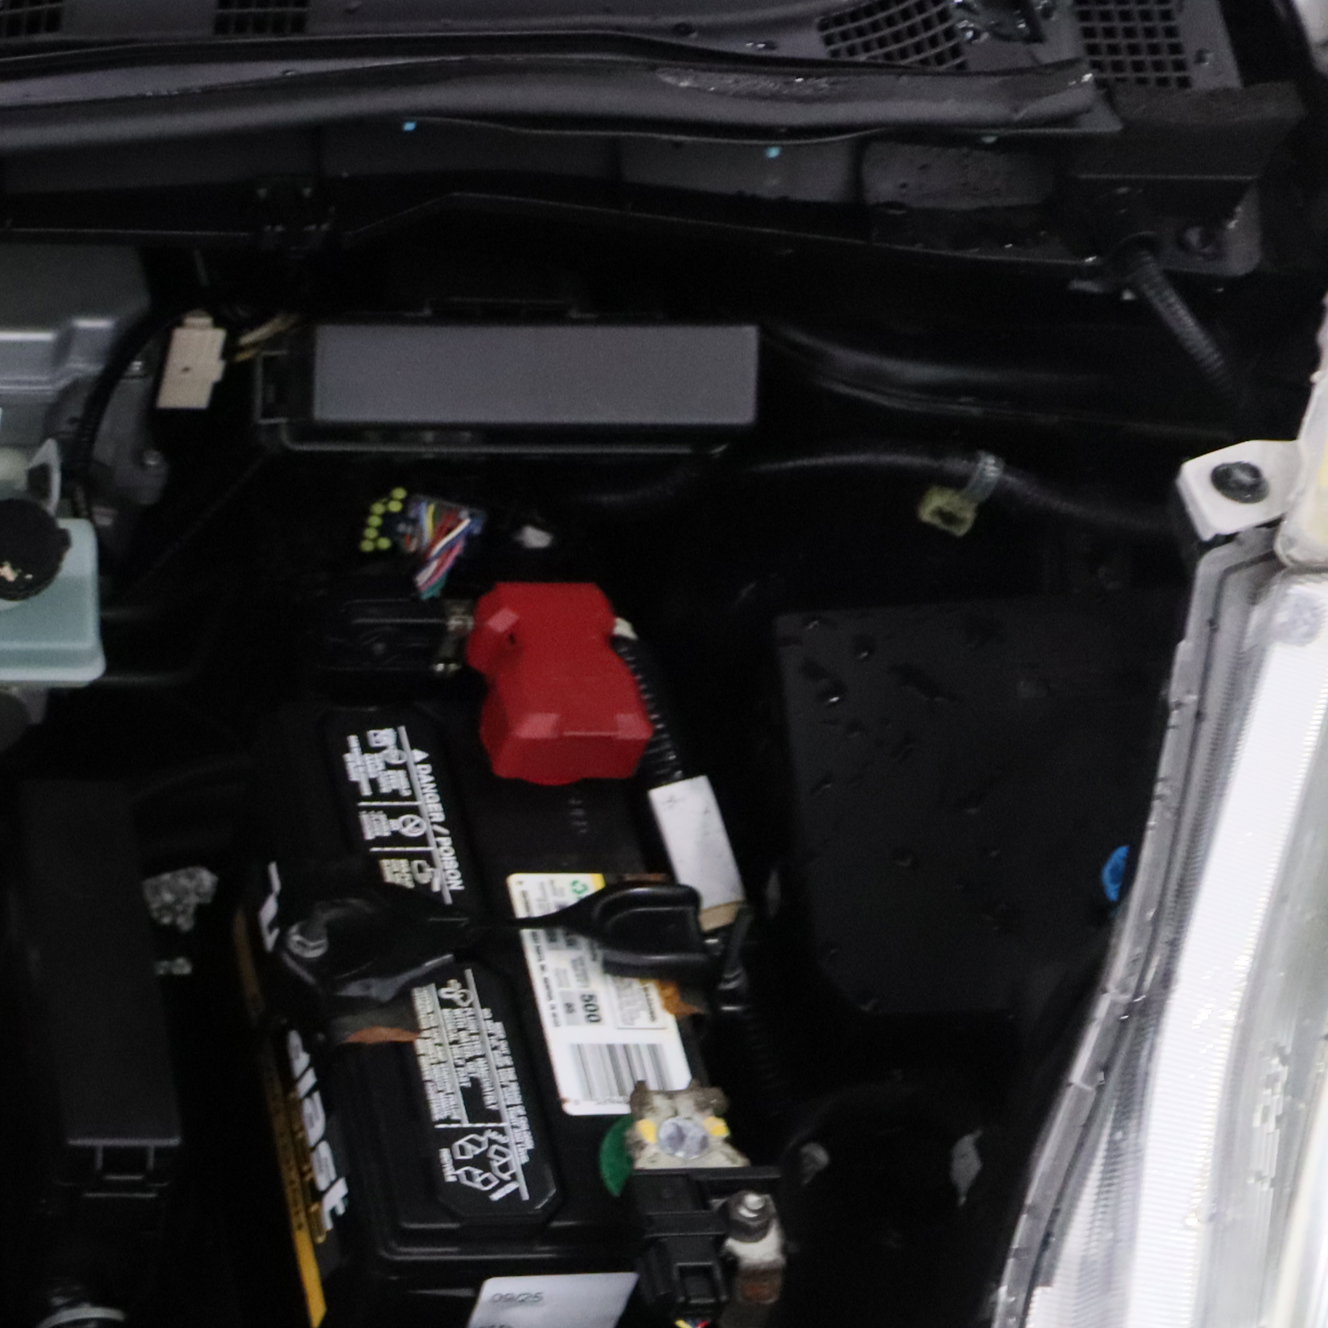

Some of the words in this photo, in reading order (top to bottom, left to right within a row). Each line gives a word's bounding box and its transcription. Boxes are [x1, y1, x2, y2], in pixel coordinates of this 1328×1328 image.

[416, 764, 445, 823] DANGER
[436, 837, 465, 890] POISON
[581, 993, 602, 1024] 500
[491, 1291, 544, 1304] 09/25
